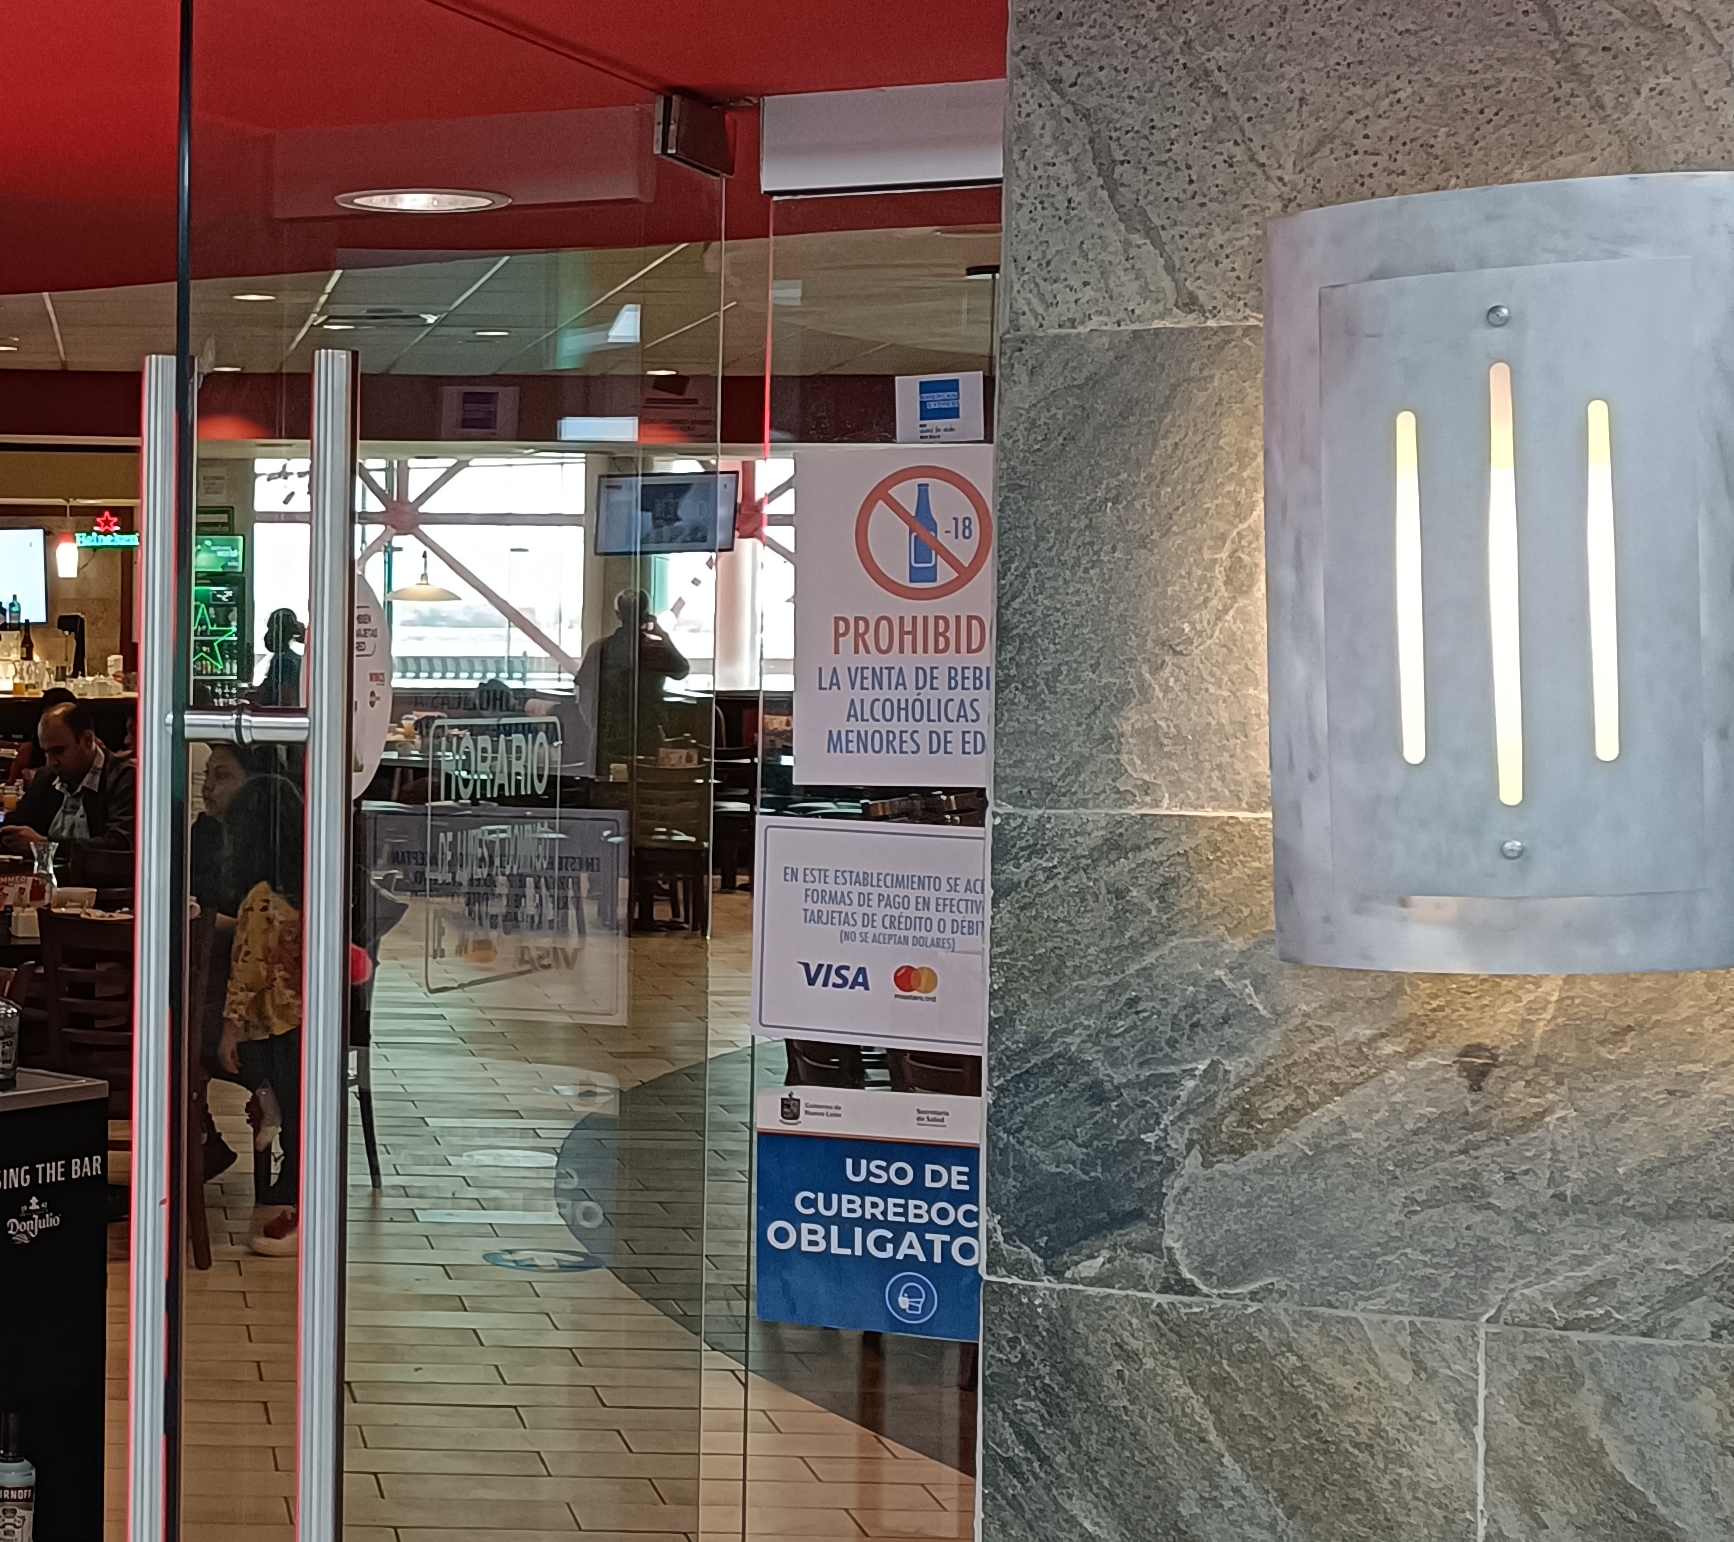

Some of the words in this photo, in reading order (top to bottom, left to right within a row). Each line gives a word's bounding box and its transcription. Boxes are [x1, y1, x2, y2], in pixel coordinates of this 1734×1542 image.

[833, 614, 987, 655] PROHIBID
[818, 666, 841, 691] LA
[847, 666, 907, 691] VENTA
[914, 666, 940, 691] DE
[947, 666, 991, 691] BEBI
[846, 692, 981, 723] ALCOHÓLICAS
[826, 729, 921, 755] MENORES
[928, 730, 954, 755] DE
[961, 730, 986, 755] ED
[440, 731, 550, 800] HORARIO
[783, 866, 799, 883] EN
[803, 867, 830, 885] ESTE
[834, 869, 942, 892] ESTABLECIMIENTO
[946, 877, 960, 893] SE
[804, 888, 853, 907] FORMAS
[858, 892, 873, 908] DE
[877, 893, 911, 911] PAGO
[916, 895, 931, 913] EN
[935, 897, 984, 915] EFECTIV
[802, 908, 858, 927] TARJETAS
[862, 912, 877, 929] DE
[881, 912, 933, 933] CRÉDITO
[937, 918, 946, 934] O
[951, 915, 984, 936] DÉBIT
[840, 929, 856, 944] (NO
[859, 931, 869, 944] SE
[871, 932, 909, 946] ACEPTAN
[912, 934, 956, 952] DOLARES)
[797, 961, 870, 991] VISA
[927, 1115, 945, 1123] Salud
[35, 1160, 65, 1184] THE
[71, 1155, 102, 1179] BAR
[845, 1158, 914, 1186] USO
[924, 1163, 970, 1190] DE
[794, 1190, 979, 1228] CUBREBOC
[766, 1220, 980, 1266] OBLIGATO
